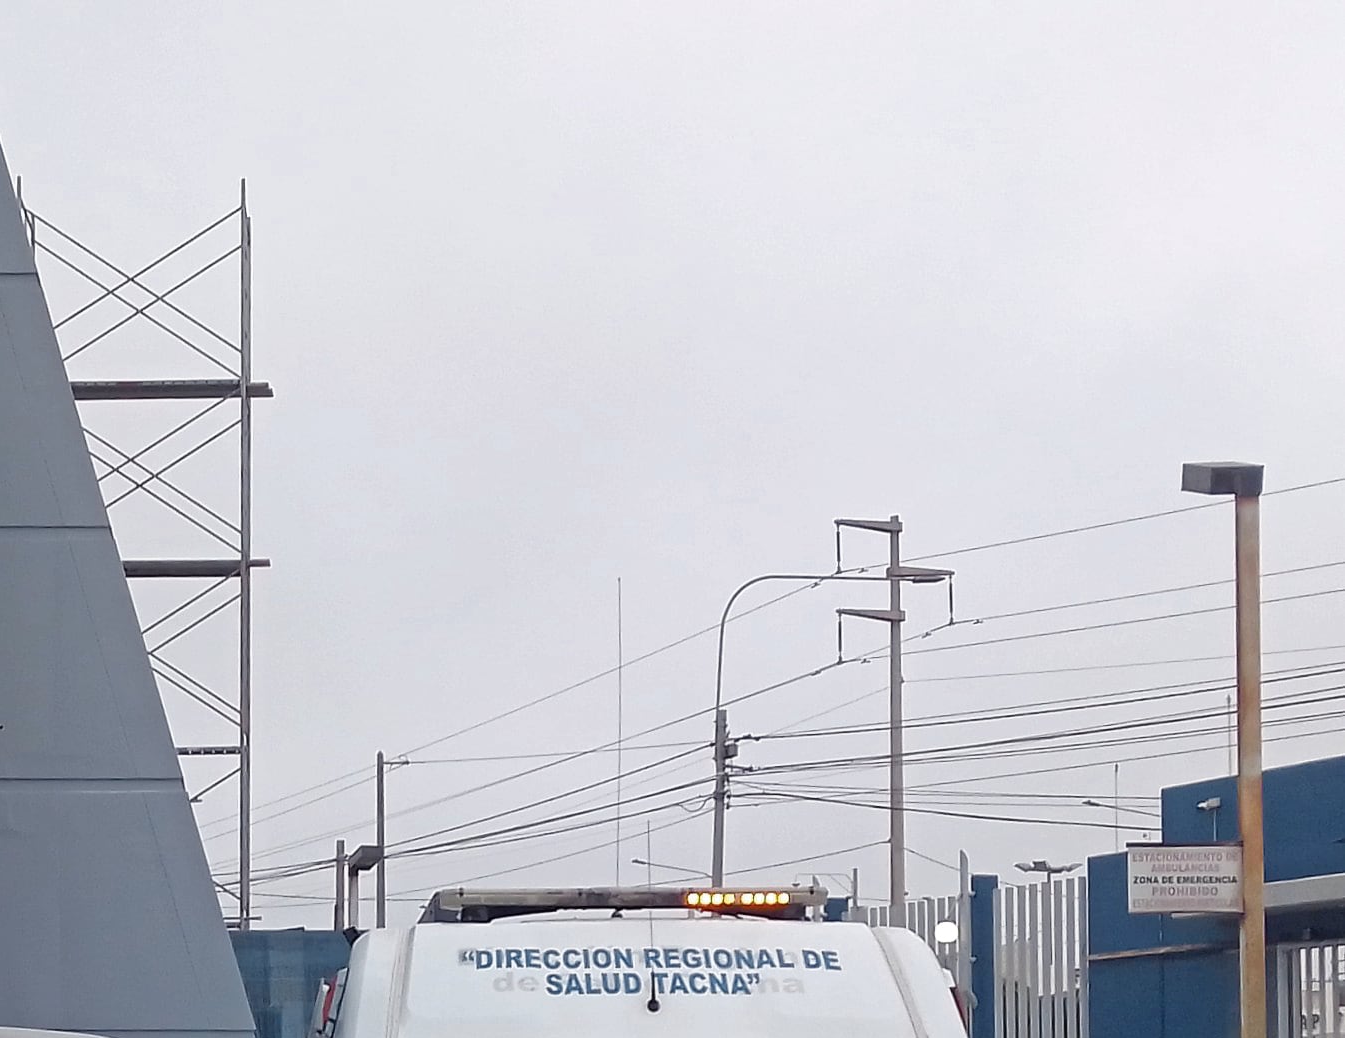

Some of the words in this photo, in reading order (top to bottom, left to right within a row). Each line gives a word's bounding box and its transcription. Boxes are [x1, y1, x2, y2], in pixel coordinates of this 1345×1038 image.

[1133, 876, 1159, 884] ZONA
[1162, 876, 1174, 884] DE
[1177, 876, 1238, 884] EMERGENCIA
[1151, 887, 1219, 897] PROHIBIDO
[643, 948, 794, 970] REGIONAL
[802, 949, 842, 971] DE
[545, 973, 642, 996] SALUD
